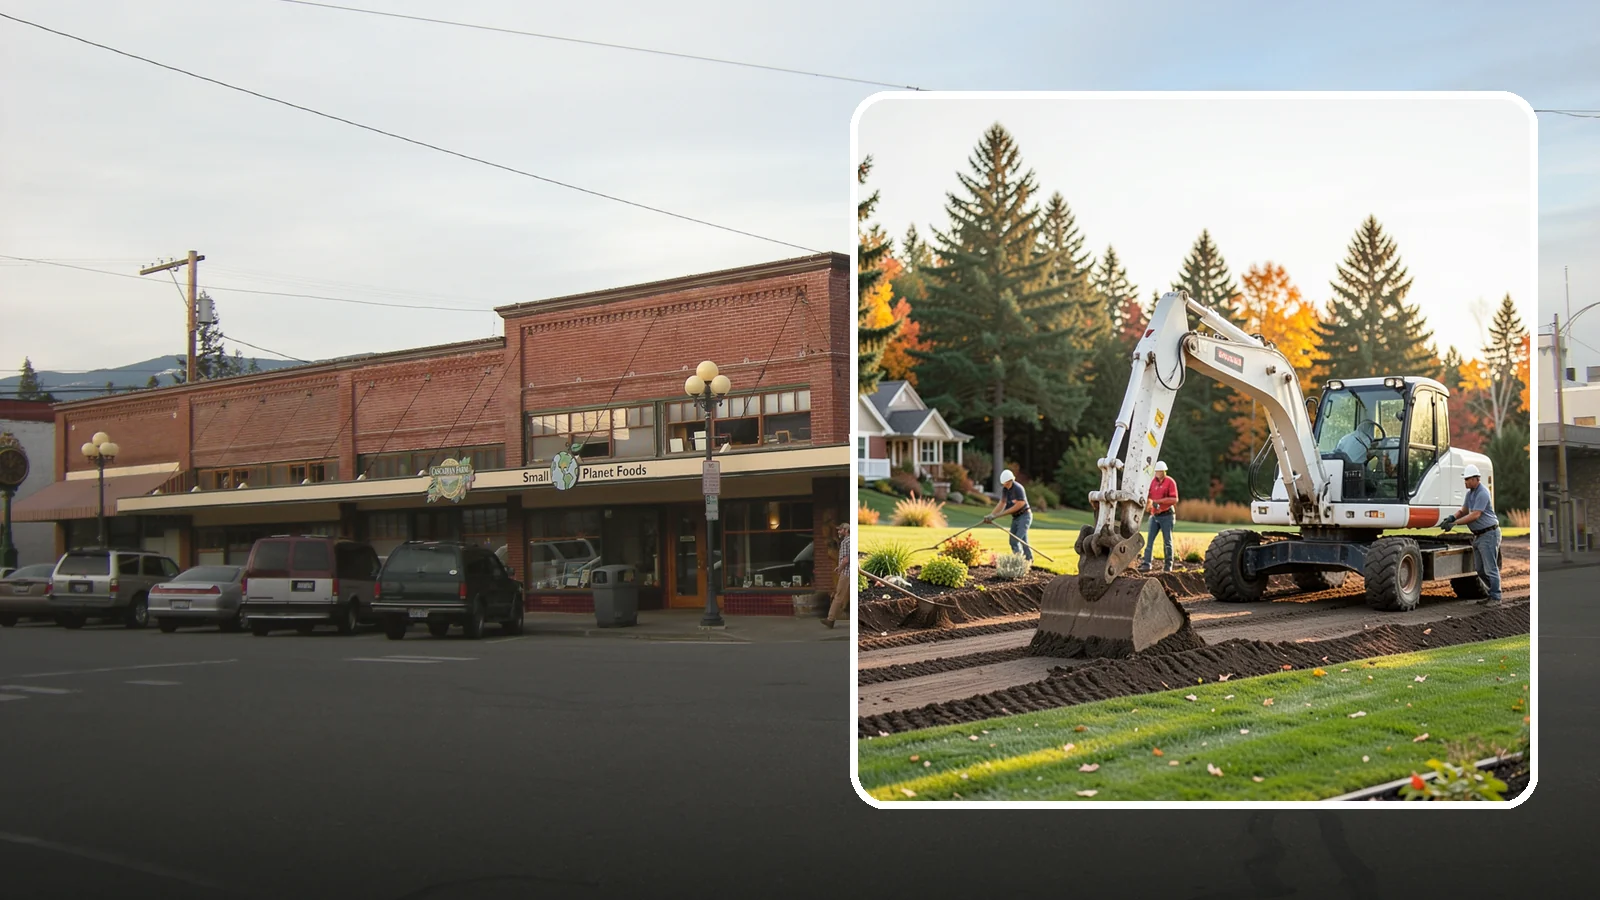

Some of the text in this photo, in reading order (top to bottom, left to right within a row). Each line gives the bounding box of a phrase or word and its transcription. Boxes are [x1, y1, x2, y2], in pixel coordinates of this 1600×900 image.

[523, 464, 647, 482] Small Planet Foods
